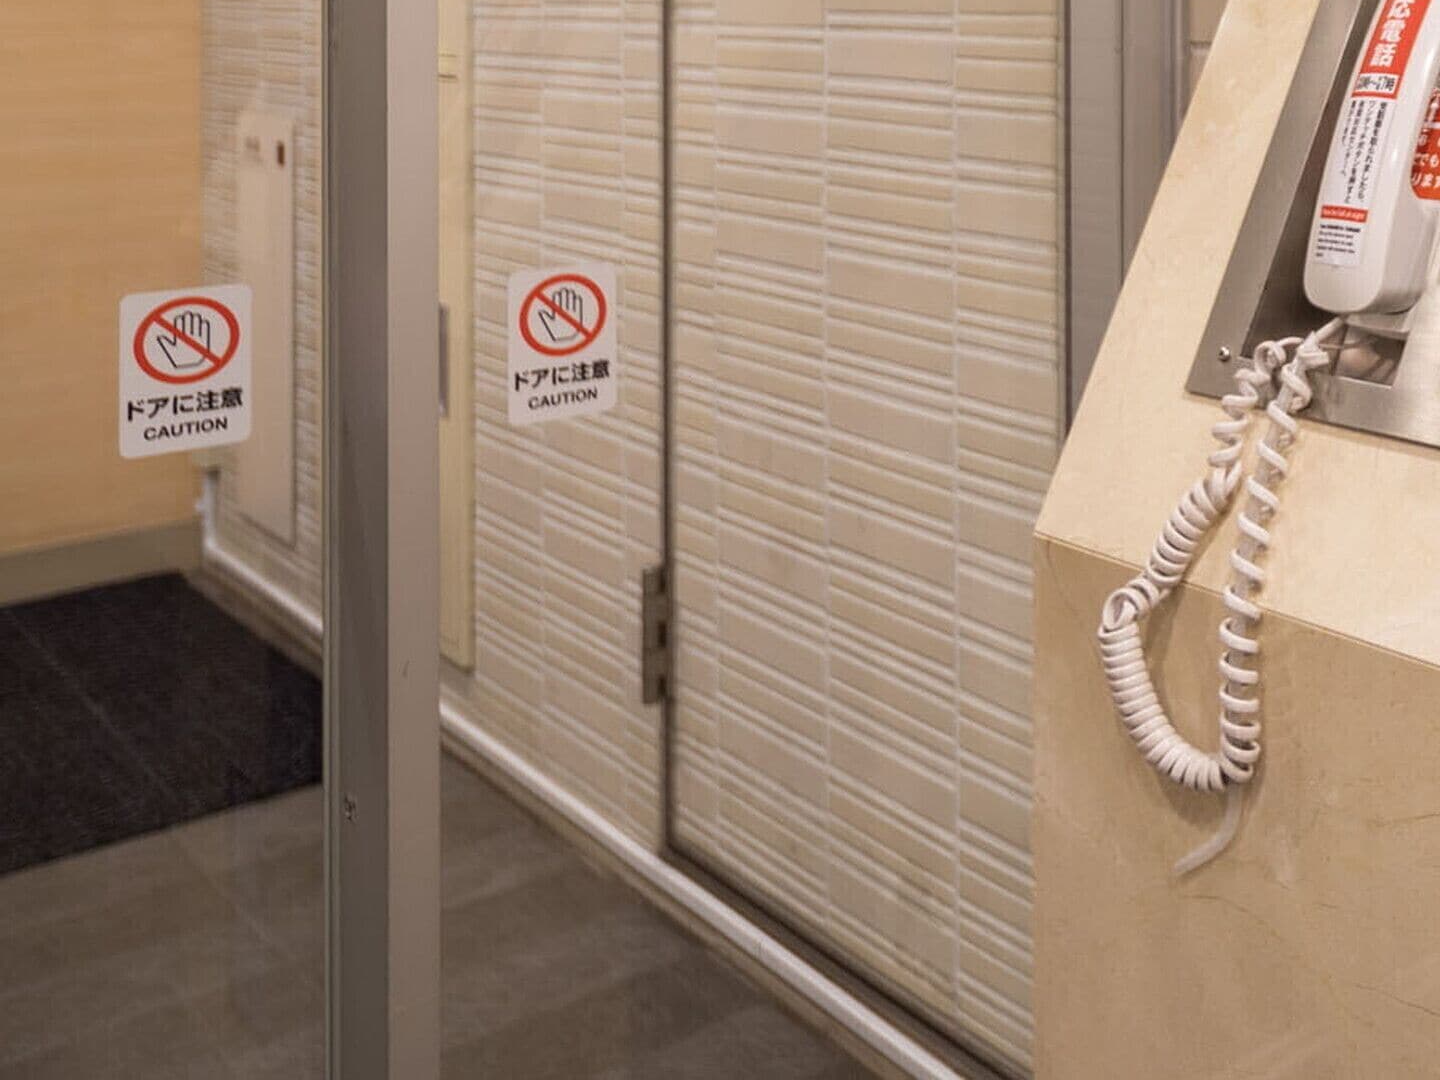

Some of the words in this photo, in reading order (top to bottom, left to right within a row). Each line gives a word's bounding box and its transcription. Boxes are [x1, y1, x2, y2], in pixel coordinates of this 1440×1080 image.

[514, 358, 610, 392] ドアに注意
[127, 386, 243, 422] ドアに注意
[528, 386, 598, 410] CAUTION
[143, 417, 228, 441] CAUTION
